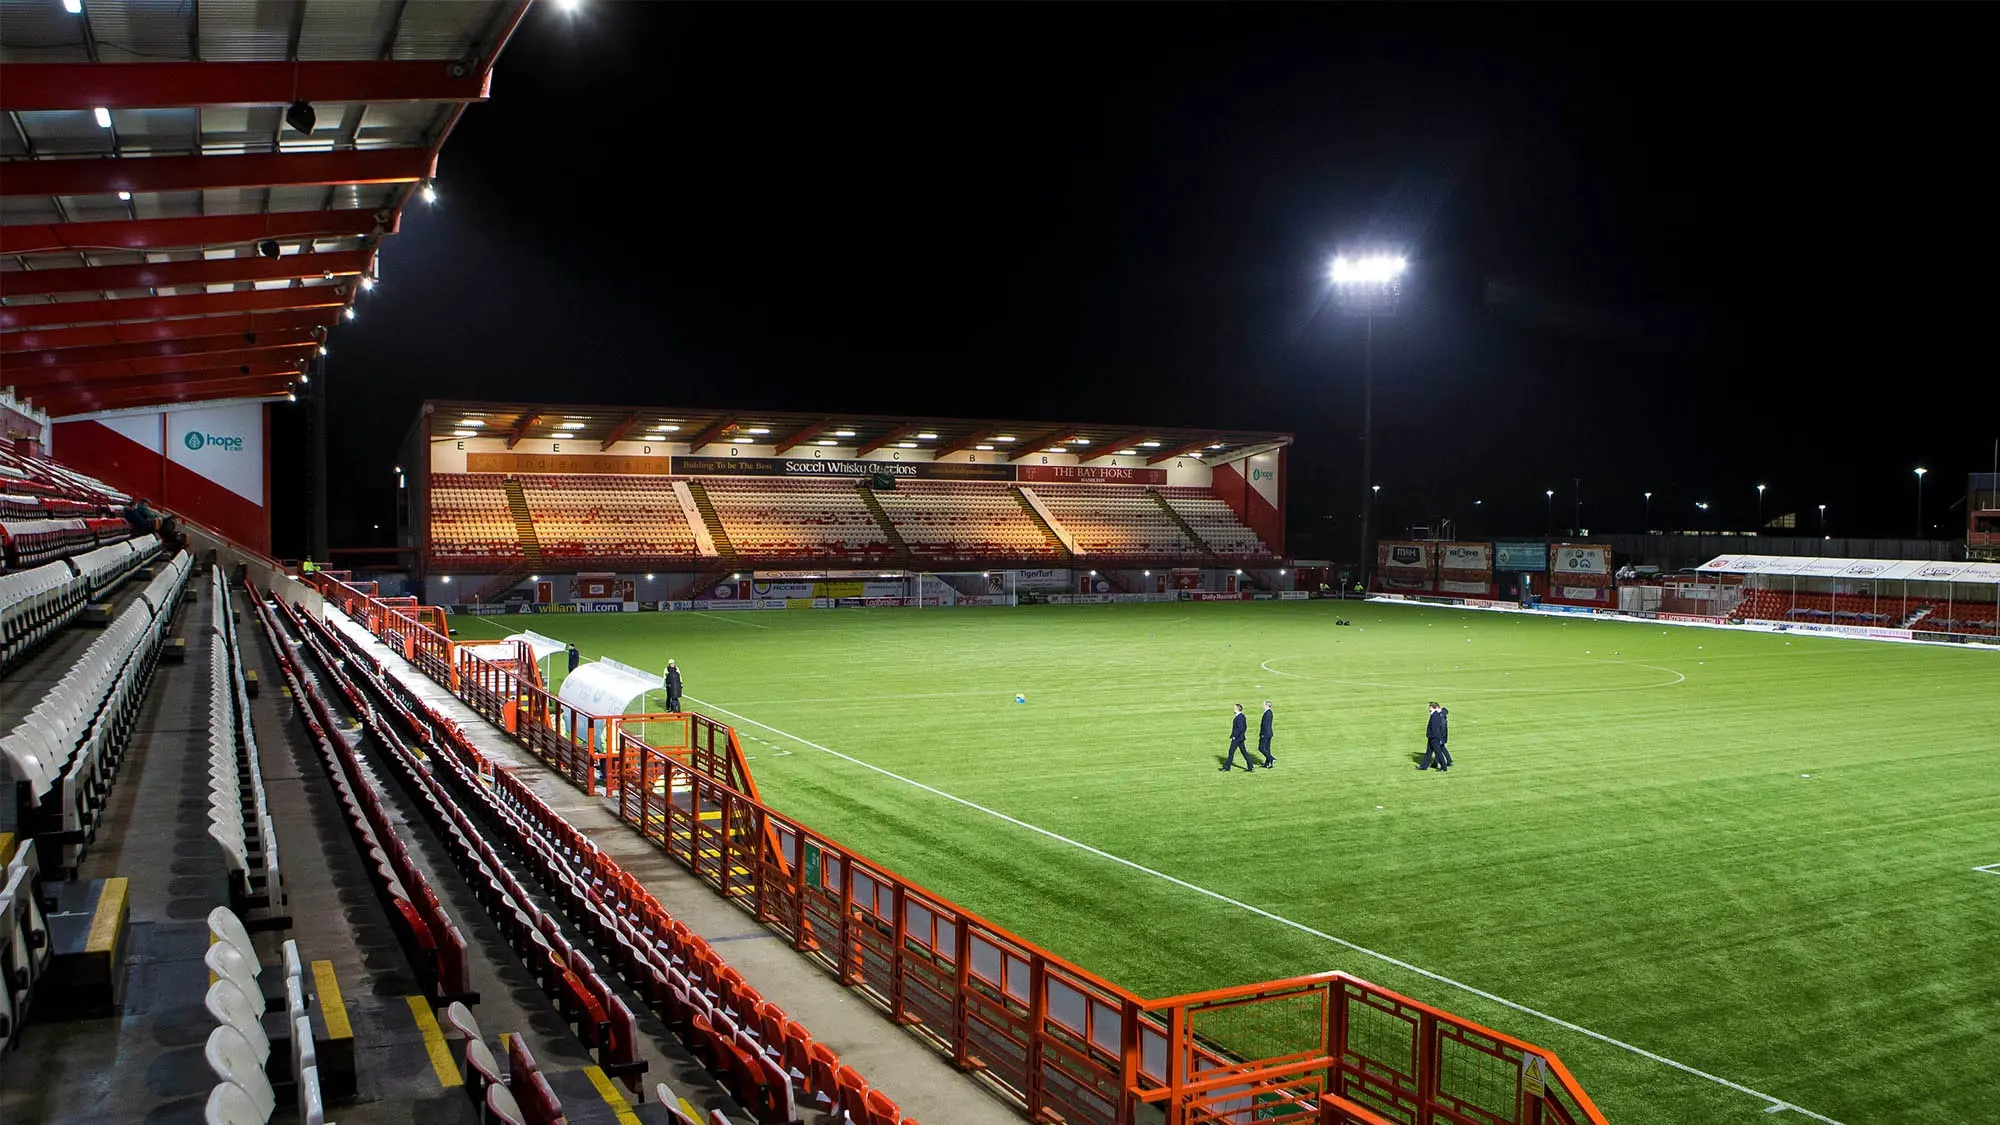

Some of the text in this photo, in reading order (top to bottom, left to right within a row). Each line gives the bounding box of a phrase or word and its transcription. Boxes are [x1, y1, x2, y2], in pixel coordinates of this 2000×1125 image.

[207, 434, 242, 450] hope
[457, 441, 464, 450] E
[553, 443, 560, 452] E
[644, 446, 651, 454] D
[731, 447, 739, 456] D
[814, 450, 821, 458] C
[893, 452, 900, 460] C
[969, 454, 976, 462] B
[1042, 456, 1048, 464] B
[1111, 458, 1117, 467] A
[785, 461, 825, 472] Scotch
[826, 462, 866, 475] Whisky
[1177, 461, 1183, 469] A
[1053, 467, 1133, 478] THE BAY HORSE
[1020, 570, 1053, 578] TigerTurf
[1202, 593, 1216, 601] Daily
[539, 602, 618, 613] williamhill.com
